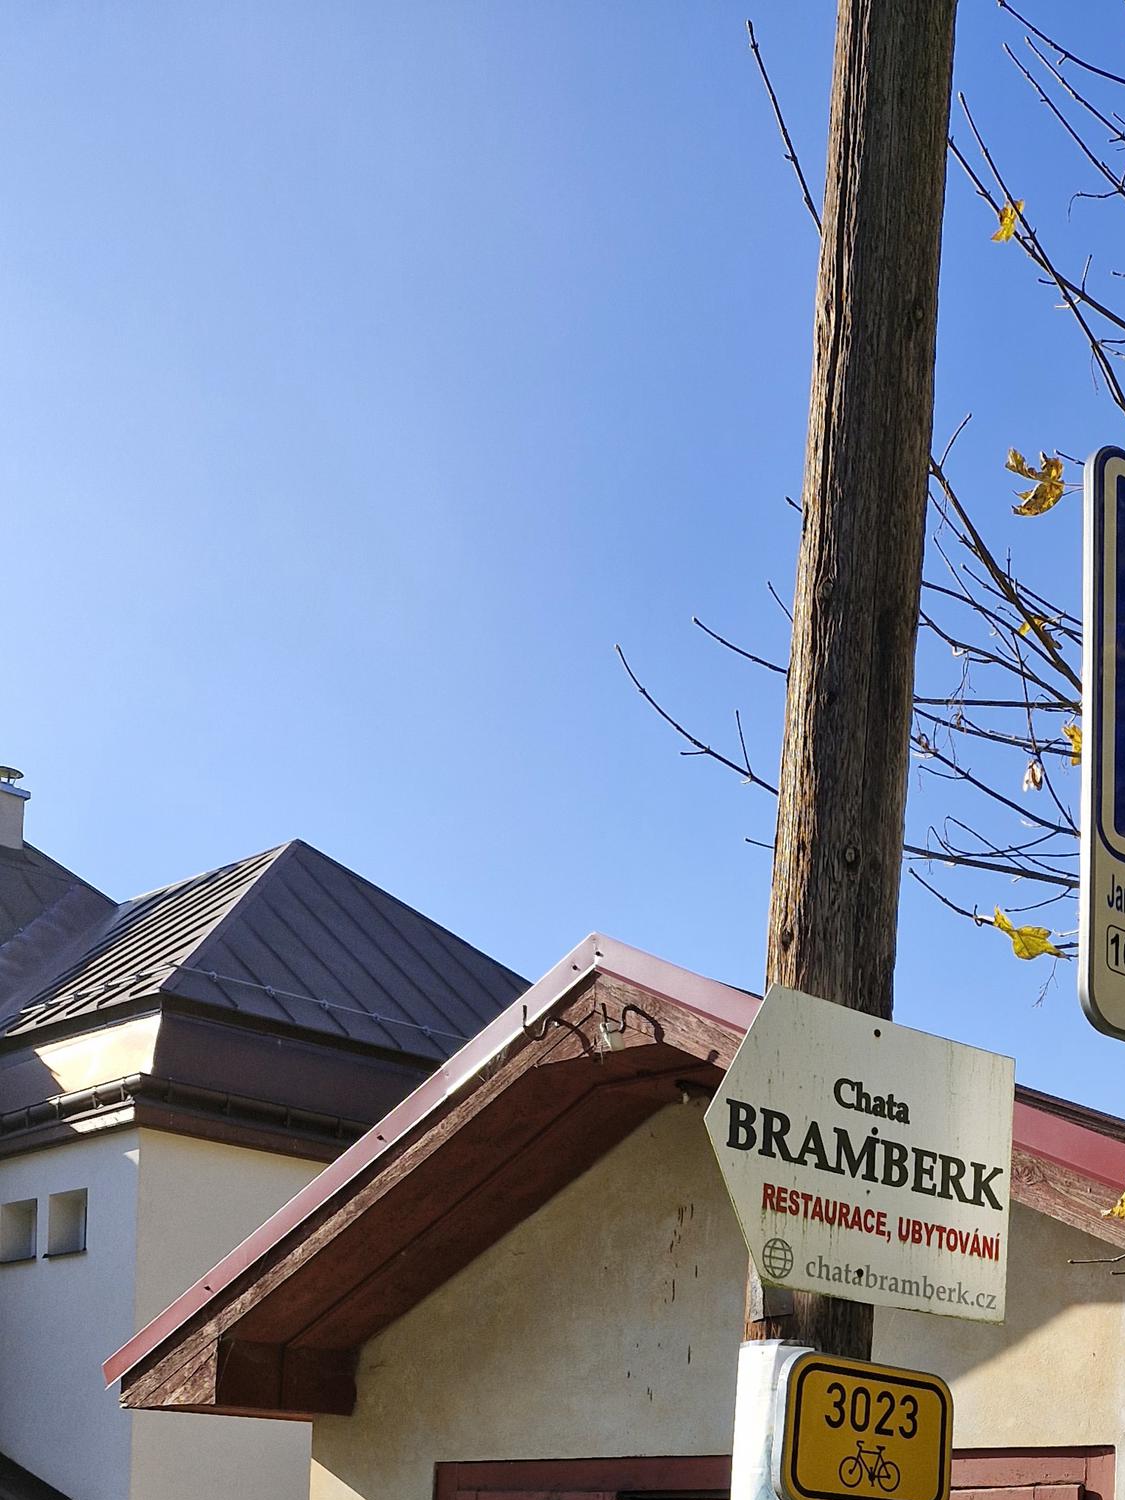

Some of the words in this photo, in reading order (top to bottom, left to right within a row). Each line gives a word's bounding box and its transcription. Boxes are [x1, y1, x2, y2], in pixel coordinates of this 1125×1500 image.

[833, 1078, 910, 1124] Chata
[725, 1098, 1003, 1211] BRAMBERK
[761, 1182, 892, 1243] RESTAURACE,
[898, 1216, 1001, 1262] UBYTOVÁNÍ
[805, 1255, 997, 1311] chatabramberk.cz
[824, 1381, 919, 1440] 3023
